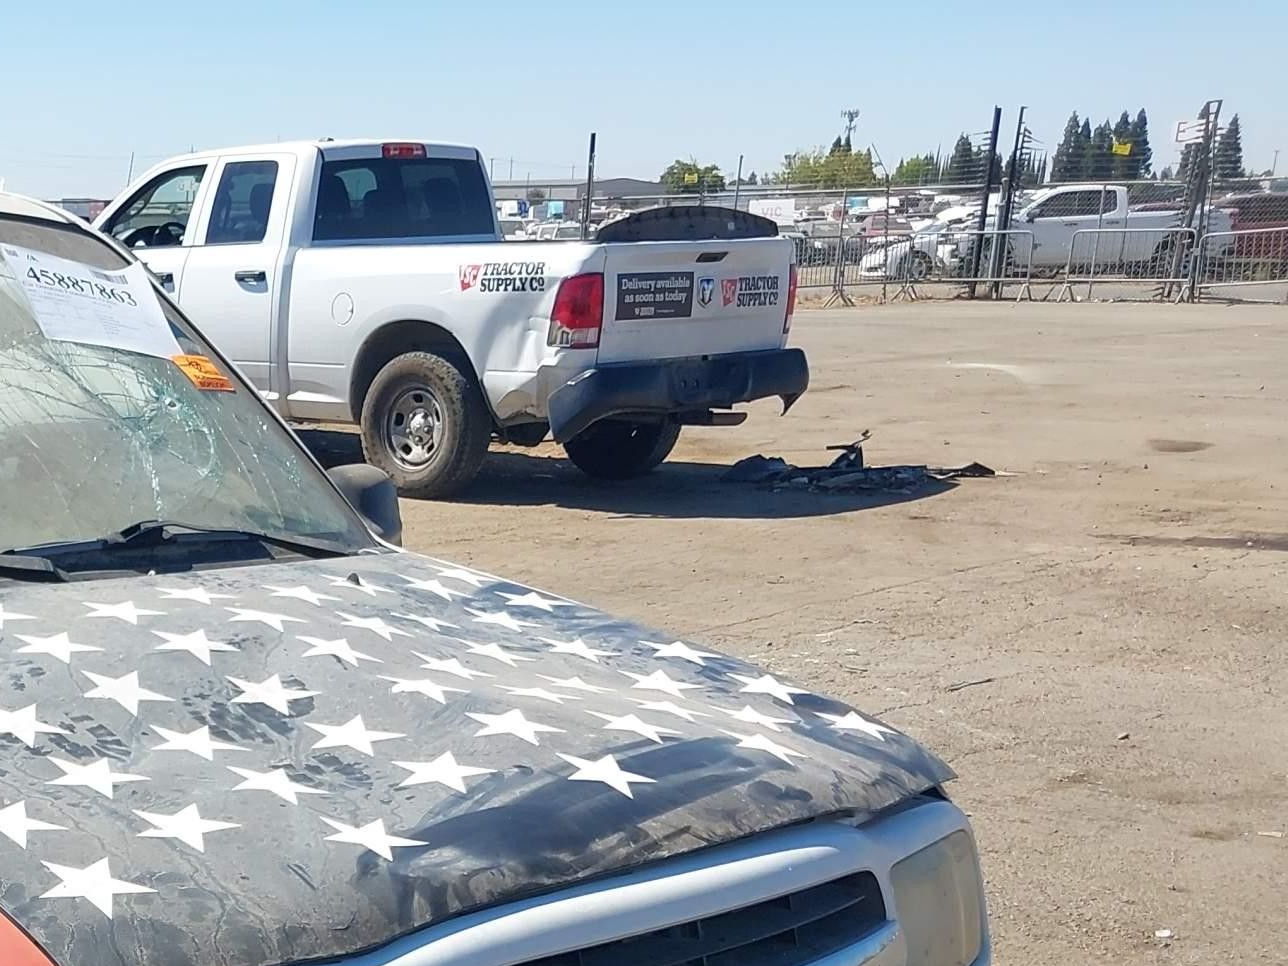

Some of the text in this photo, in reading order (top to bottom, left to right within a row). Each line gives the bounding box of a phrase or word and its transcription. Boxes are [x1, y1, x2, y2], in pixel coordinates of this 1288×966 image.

[483, 262, 546, 276] TRACTOR
[26, 266, 138, 307] 45887863
[480, 277, 528, 292] SUPPLY
[621, 276, 690, 291] Delivery available
[738, 276, 779, 291] TRACTOR
[624, 290, 687, 304] as soon as today
[737, 292, 768, 307] SUPPLY
